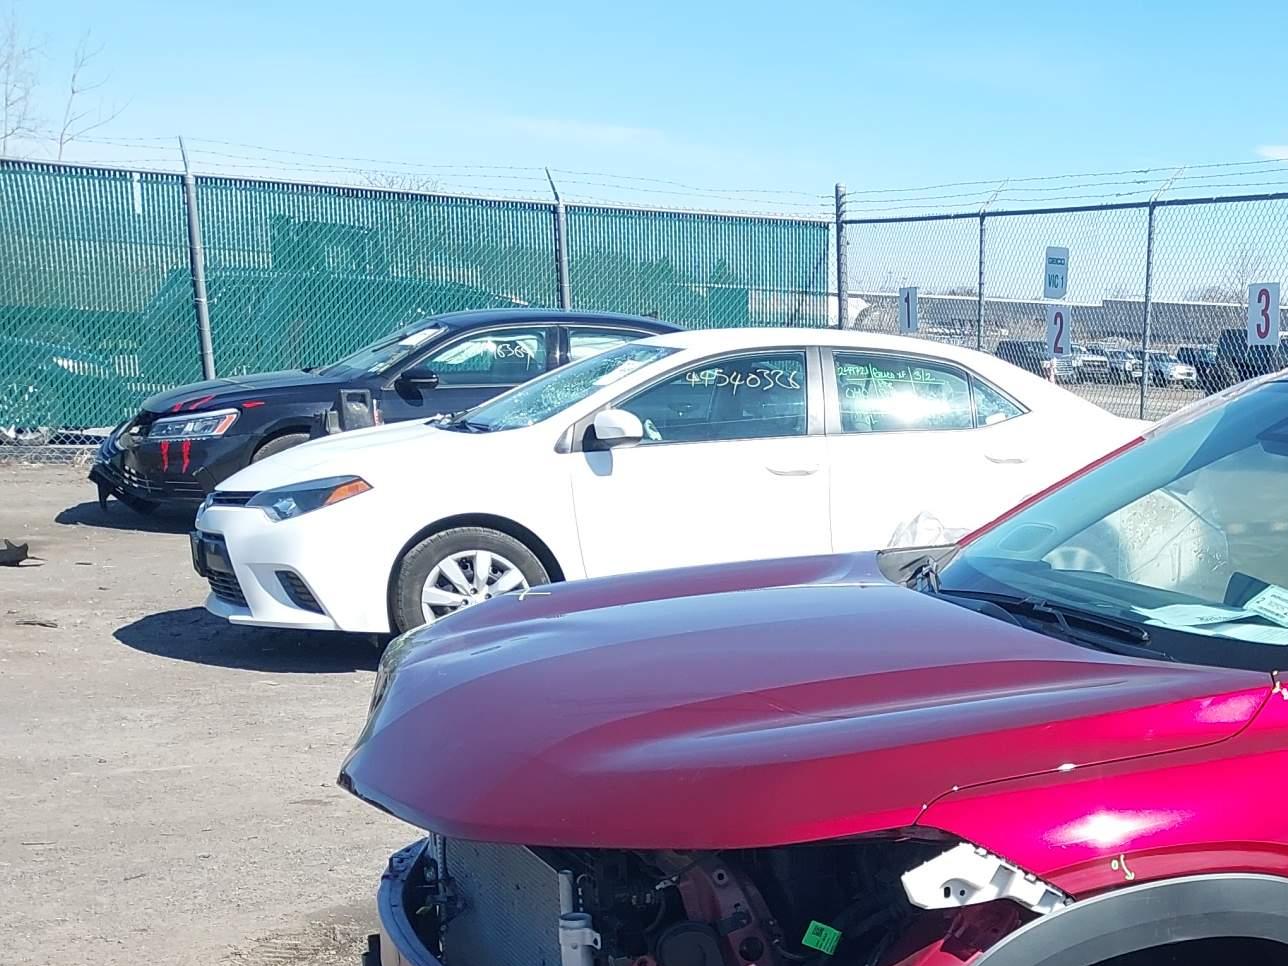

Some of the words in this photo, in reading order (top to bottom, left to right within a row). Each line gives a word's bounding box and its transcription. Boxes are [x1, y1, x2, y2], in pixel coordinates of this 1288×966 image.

[1048, 257, 1065, 266] GEICO
[904, 292, 911, 328] 1
[1256, 288, 1271, 340] 3
[1053, 311, 1064, 354] 2
